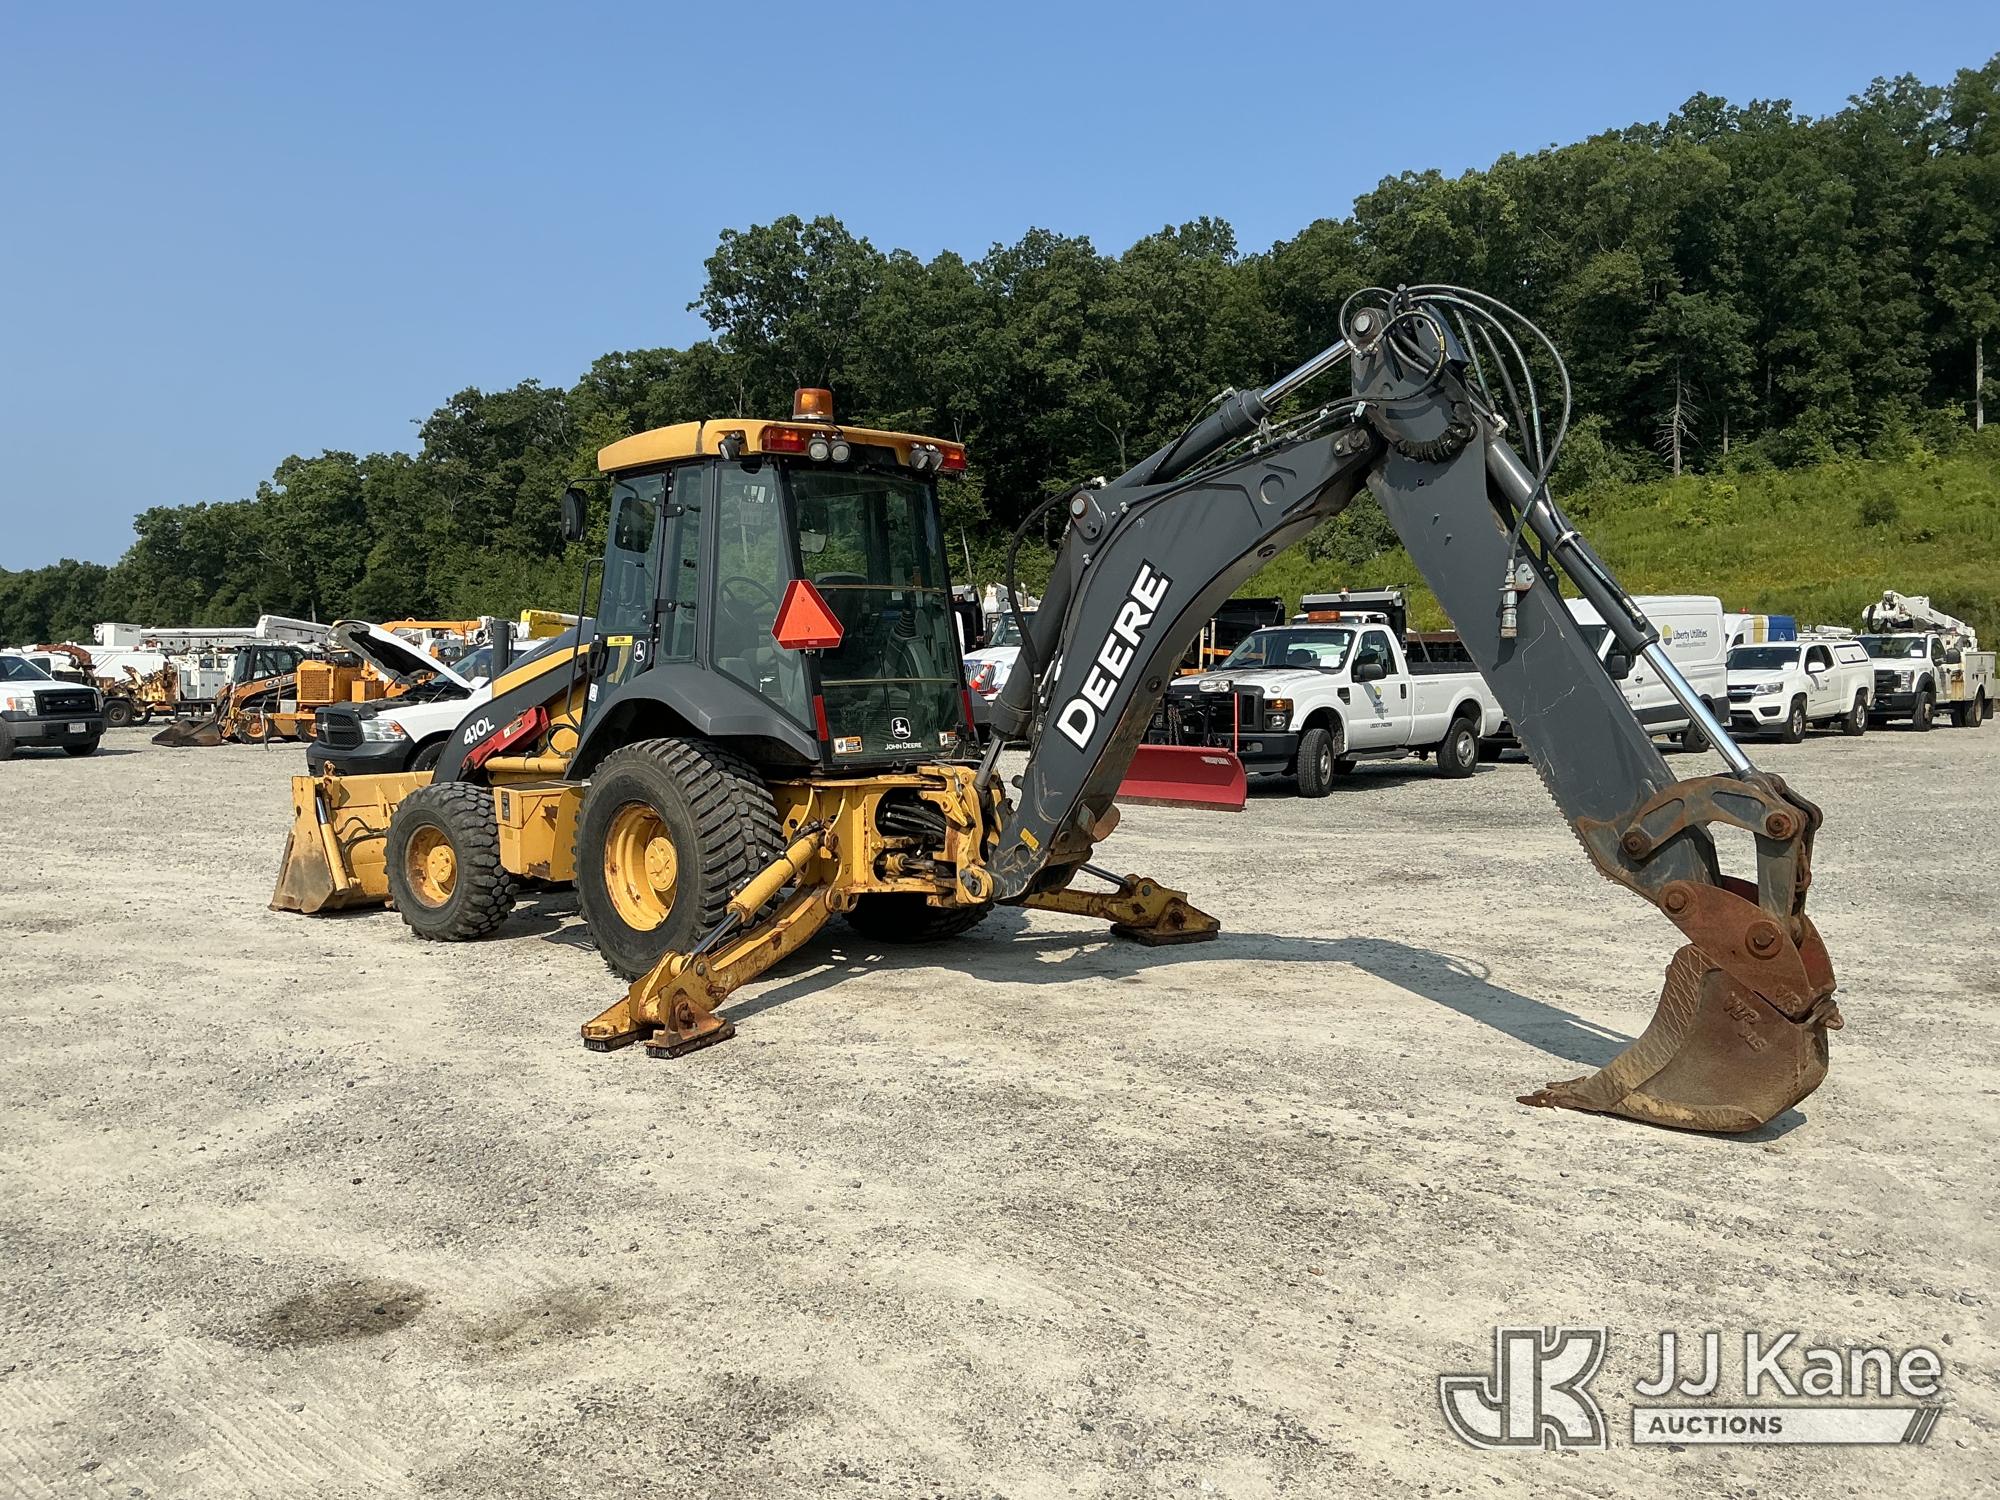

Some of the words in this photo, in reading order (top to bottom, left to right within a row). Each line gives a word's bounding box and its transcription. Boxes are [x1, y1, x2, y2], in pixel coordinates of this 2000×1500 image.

[1056, 564, 1169, 749] DEERE
[265, 675, 294, 688] CA
[463, 716, 496, 746] 410L
[884, 742, 902, 751] JOHN
[902, 741, 923, 750] DEERE
